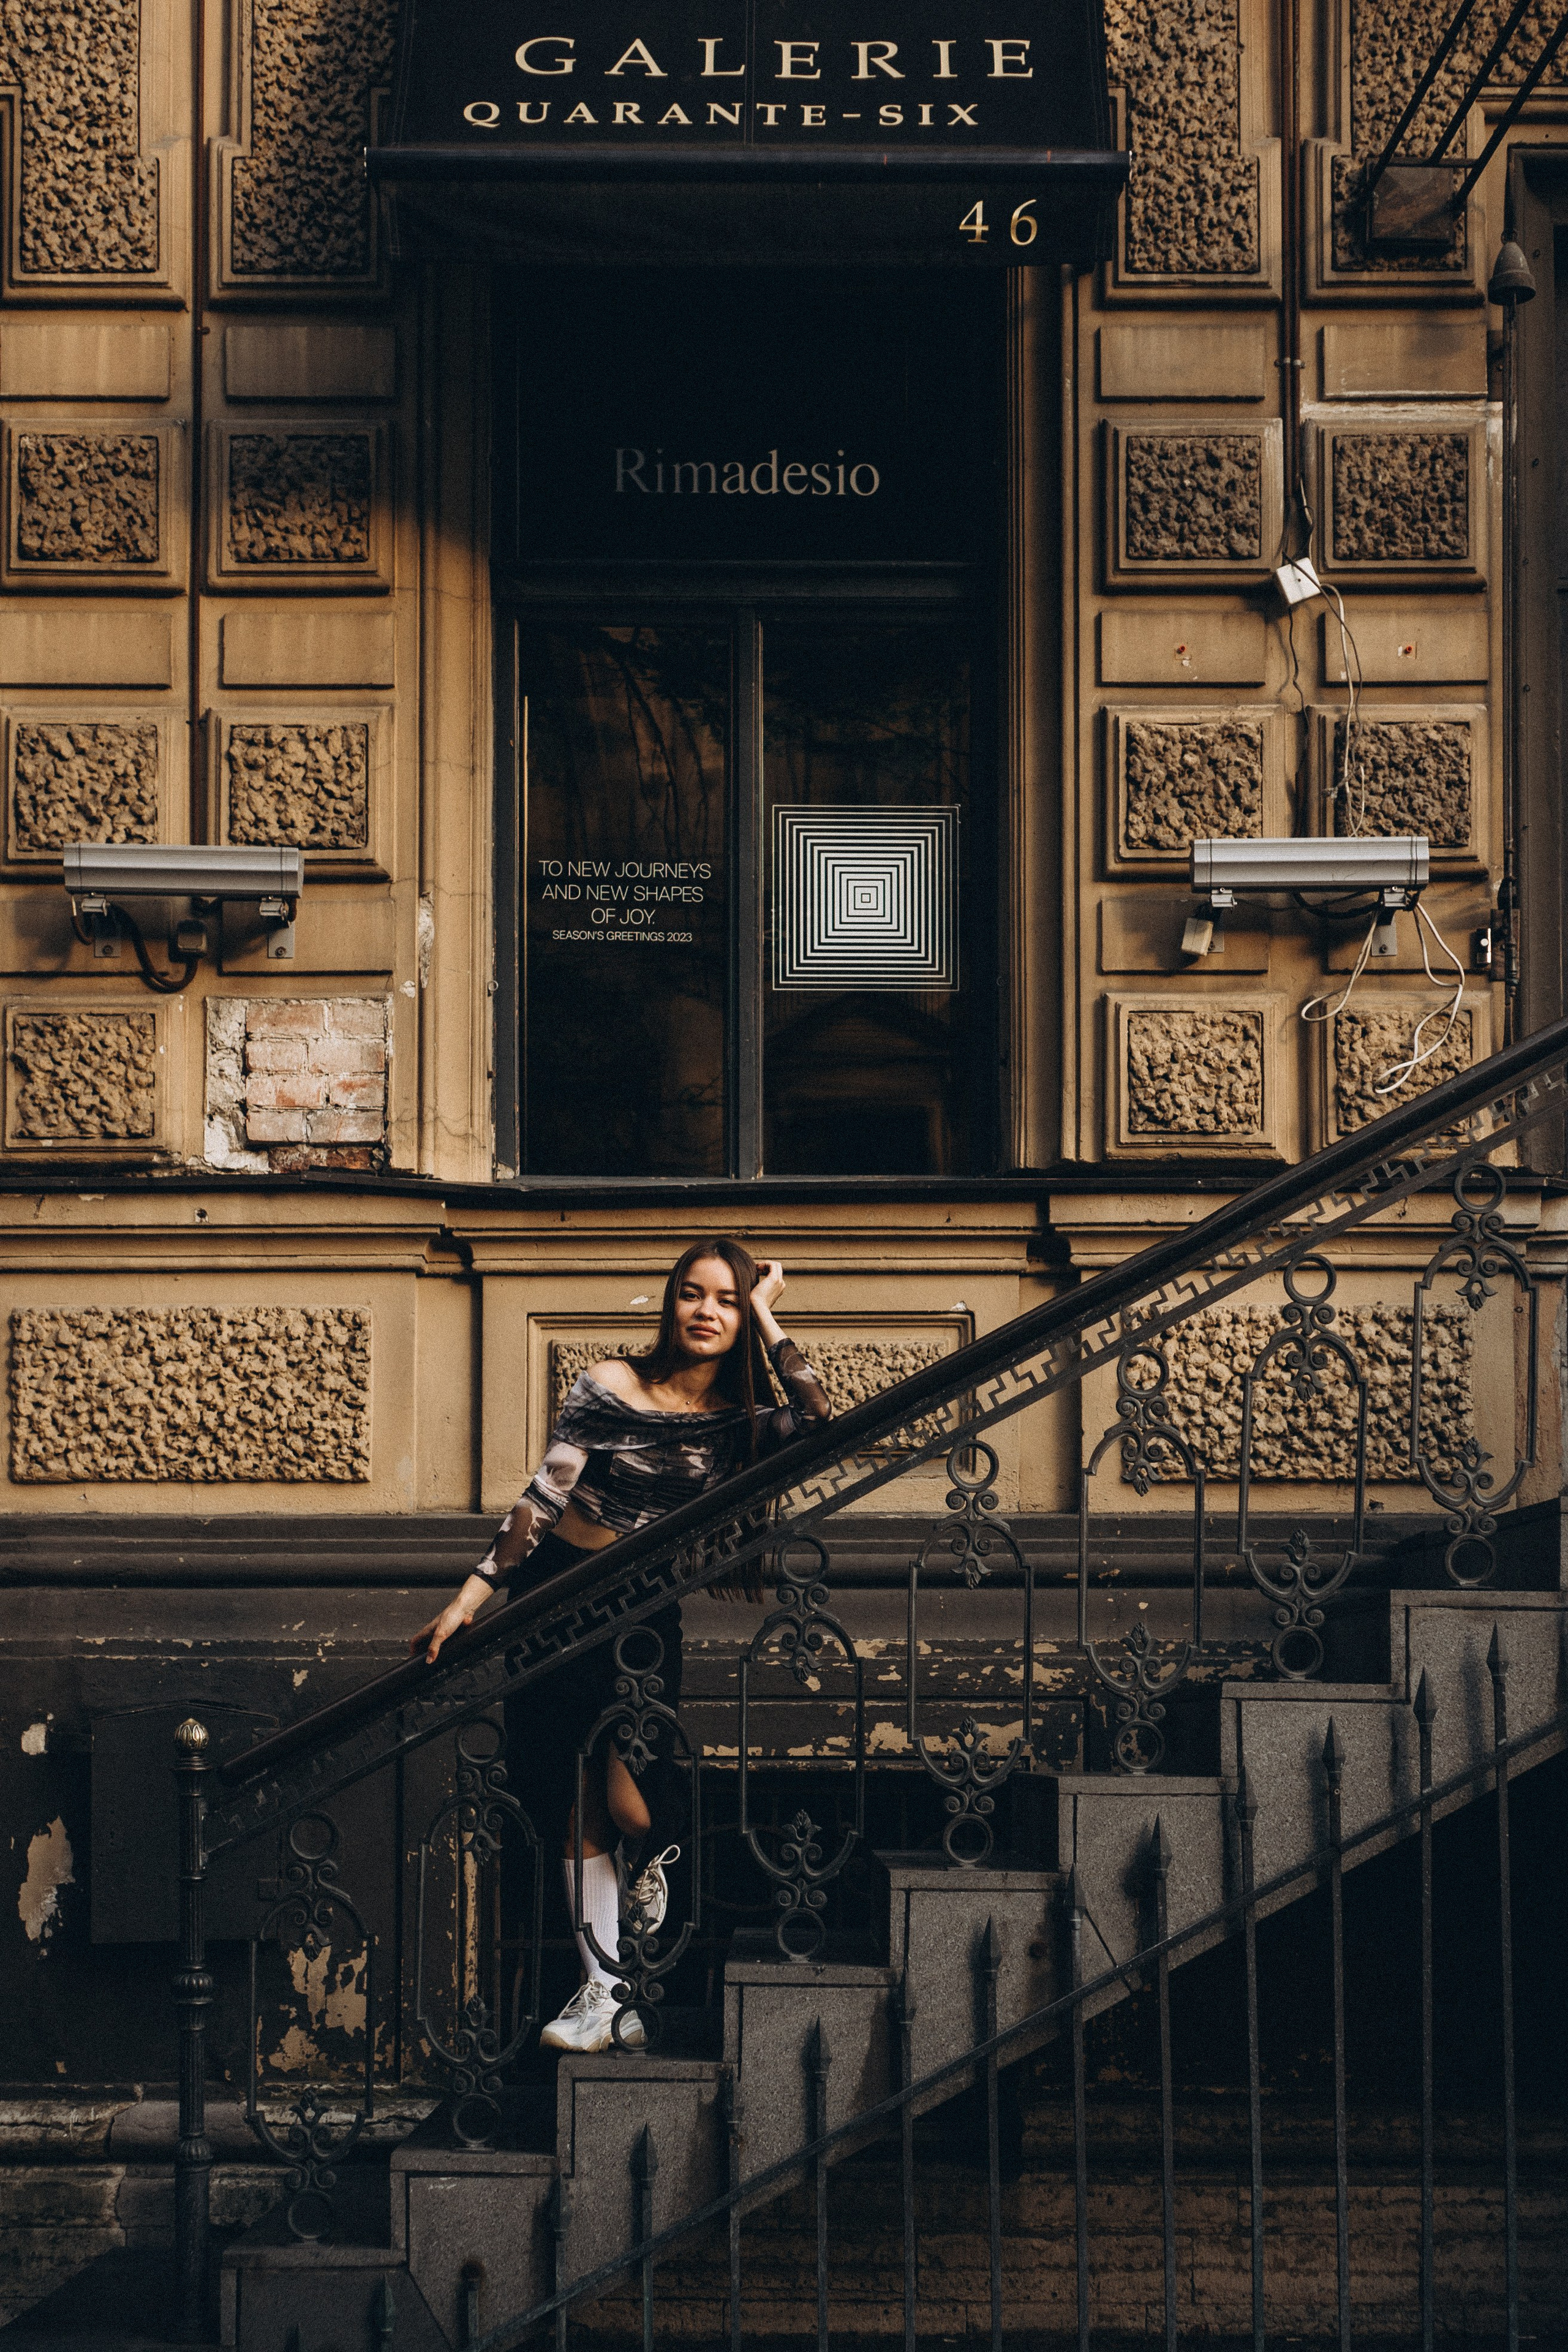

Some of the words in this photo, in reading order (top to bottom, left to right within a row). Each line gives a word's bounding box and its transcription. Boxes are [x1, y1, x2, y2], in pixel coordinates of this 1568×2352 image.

[515, 36, 1034, 79] GALERIE
[463, 100, 979, 128] QUARANTE-SIX
[959, 198, 1038, 246] 46
[615, 448, 880, 497] Rimadesio
[538, 860, 563, 876] TO
[568, 861, 611, 877] NEW
[614, 862, 712, 880] JOURNEYS
[542, 884, 581, 900] AND
[586, 884, 629, 901] NEW
[633, 885, 704, 903] SHAPES
[590, 907, 616, 924] OF
[619, 908, 656, 925] JOY.
[552, 929, 605, 941] SEASON'S
[606, 930, 665, 942] GREETINGS
[666, 932, 693, 942] 2023
